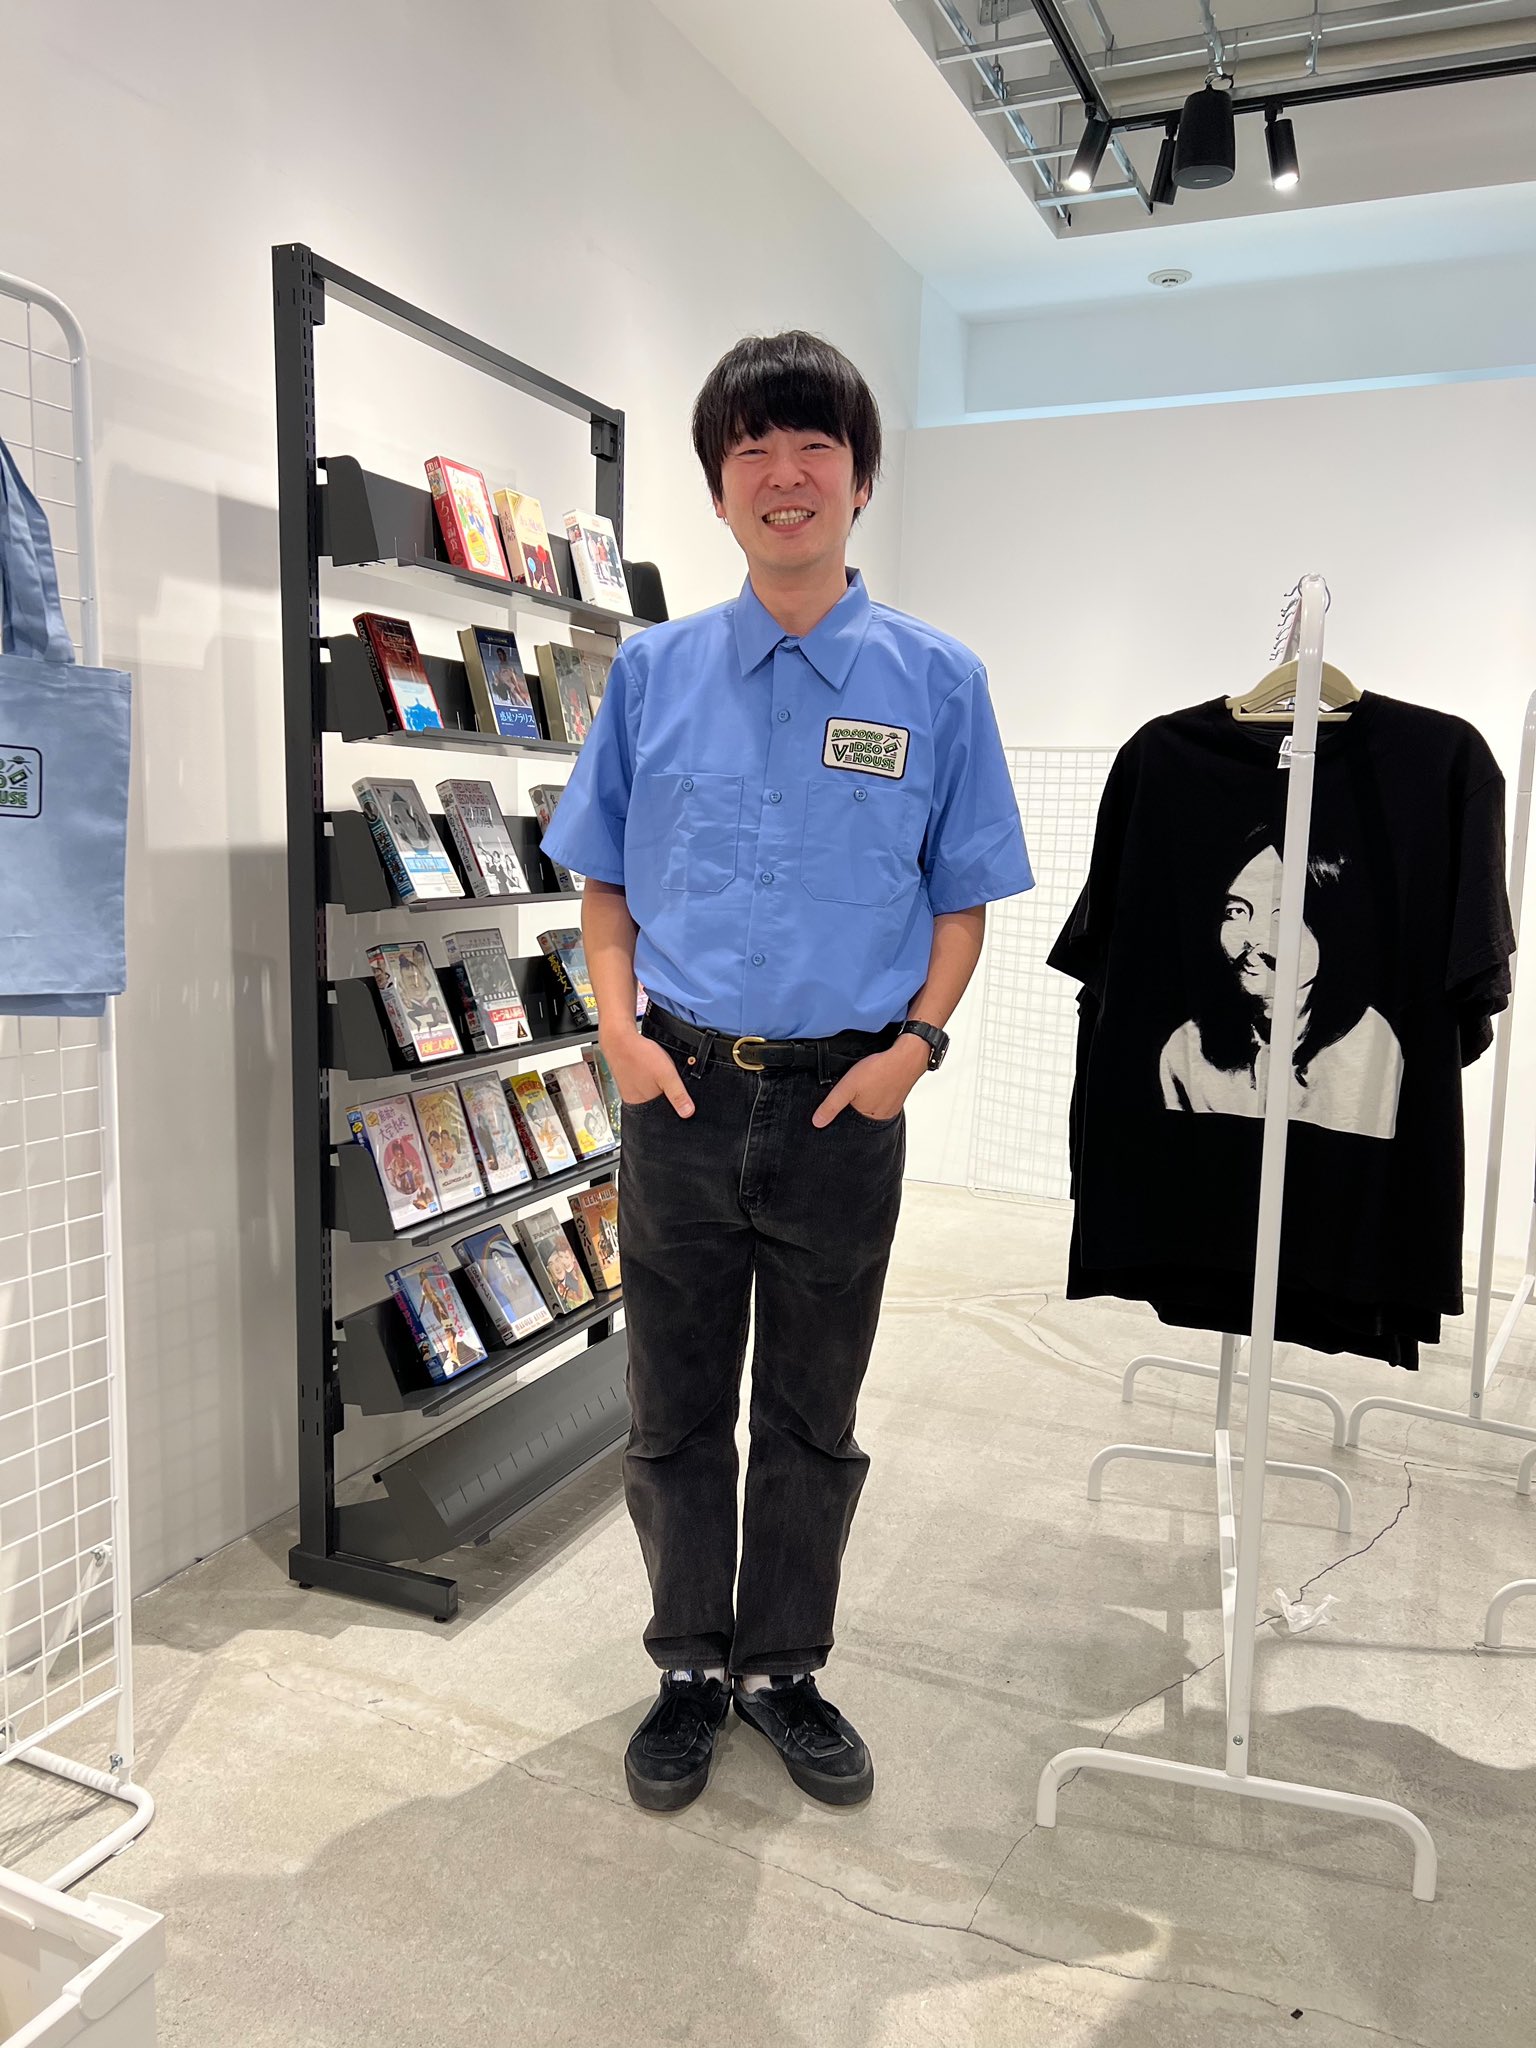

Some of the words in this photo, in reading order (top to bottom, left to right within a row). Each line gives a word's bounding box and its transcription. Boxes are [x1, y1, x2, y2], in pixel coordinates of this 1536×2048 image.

[500, 711, 535, 724] 惑星ソラリス
[832, 729, 883, 742] HOSONO
[832, 742, 883, 761] VIDEO
[853, 753, 896, 769] HOUSE
[548, 954, 572, 993] 荒野の七人
